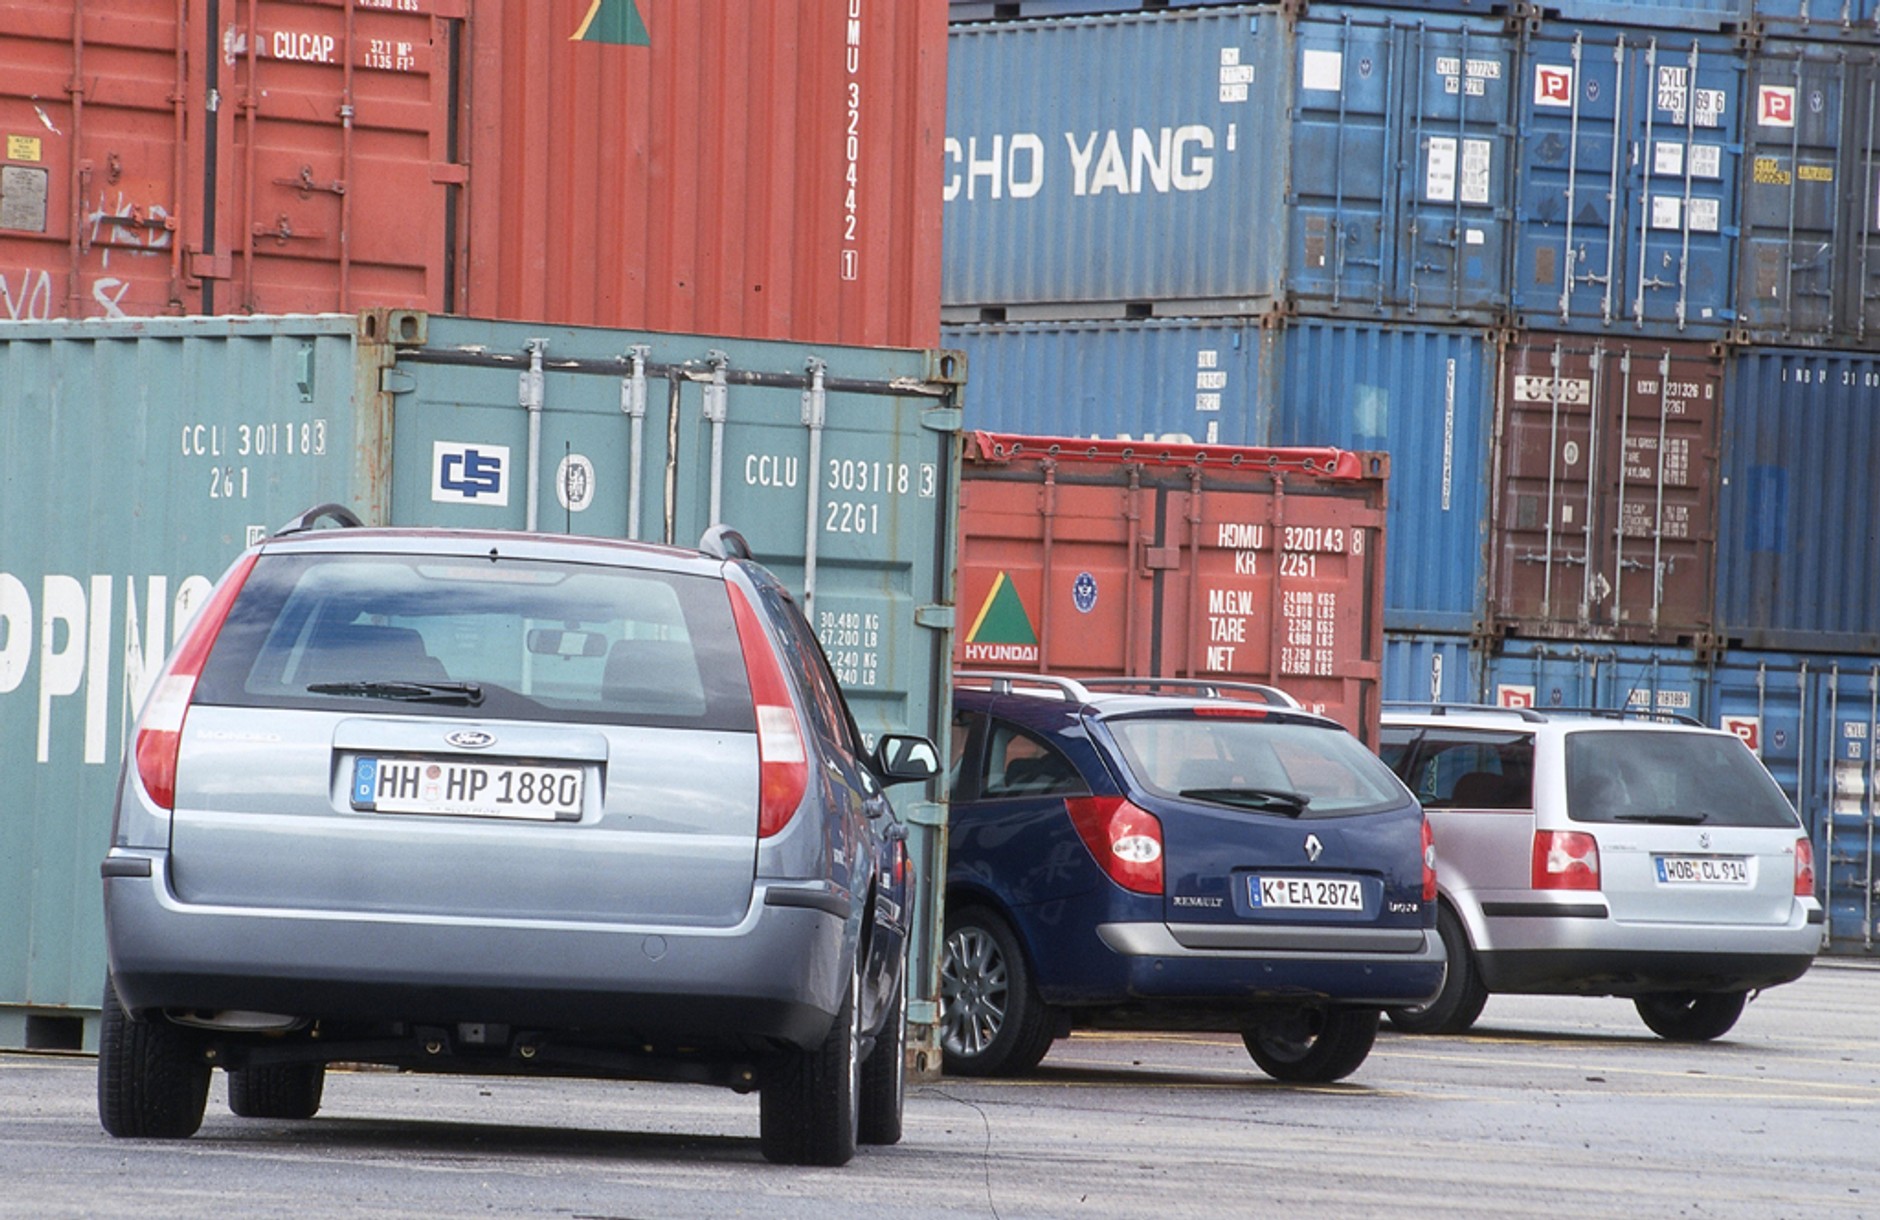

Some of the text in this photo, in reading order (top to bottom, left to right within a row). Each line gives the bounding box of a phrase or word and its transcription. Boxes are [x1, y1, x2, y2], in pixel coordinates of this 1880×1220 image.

[273, 31, 335, 63] CU.CAP.
[1659, 67, 1688, 88] CYLU
[844, 82, 859, 241] 320442
[1064, 125, 1215, 196] YANG
[745, 454, 799, 488] CCLU
[828, 458, 909, 494] 303118
[825, 501, 879, 535] 22G1
[1218, 523, 1263, 549] HDMU
[1284, 526, 1344, 553] 320143
[1235, 551, 1316, 577] KR 2251
[1208, 589, 1254, 616] M.G.W.
[821, 611, 879, 630] 30.480 KG
[1208, 617, 1246, 643] TARE
[864, 631, 878, 648] LB
[862, 652, 877, 669] KG
[965, 645, 1038, 661] HYUNDAI
[1206, 646, 1235, 672] NET
[862, 670, 875, 686] LB
[360, 784, 370, 795] D
[378, 764, 576, 806] HH HP 1880
[1665, 861, 1745, 880] WOB CL 914
[1262, 881, 1360, 906] K EA 2874
